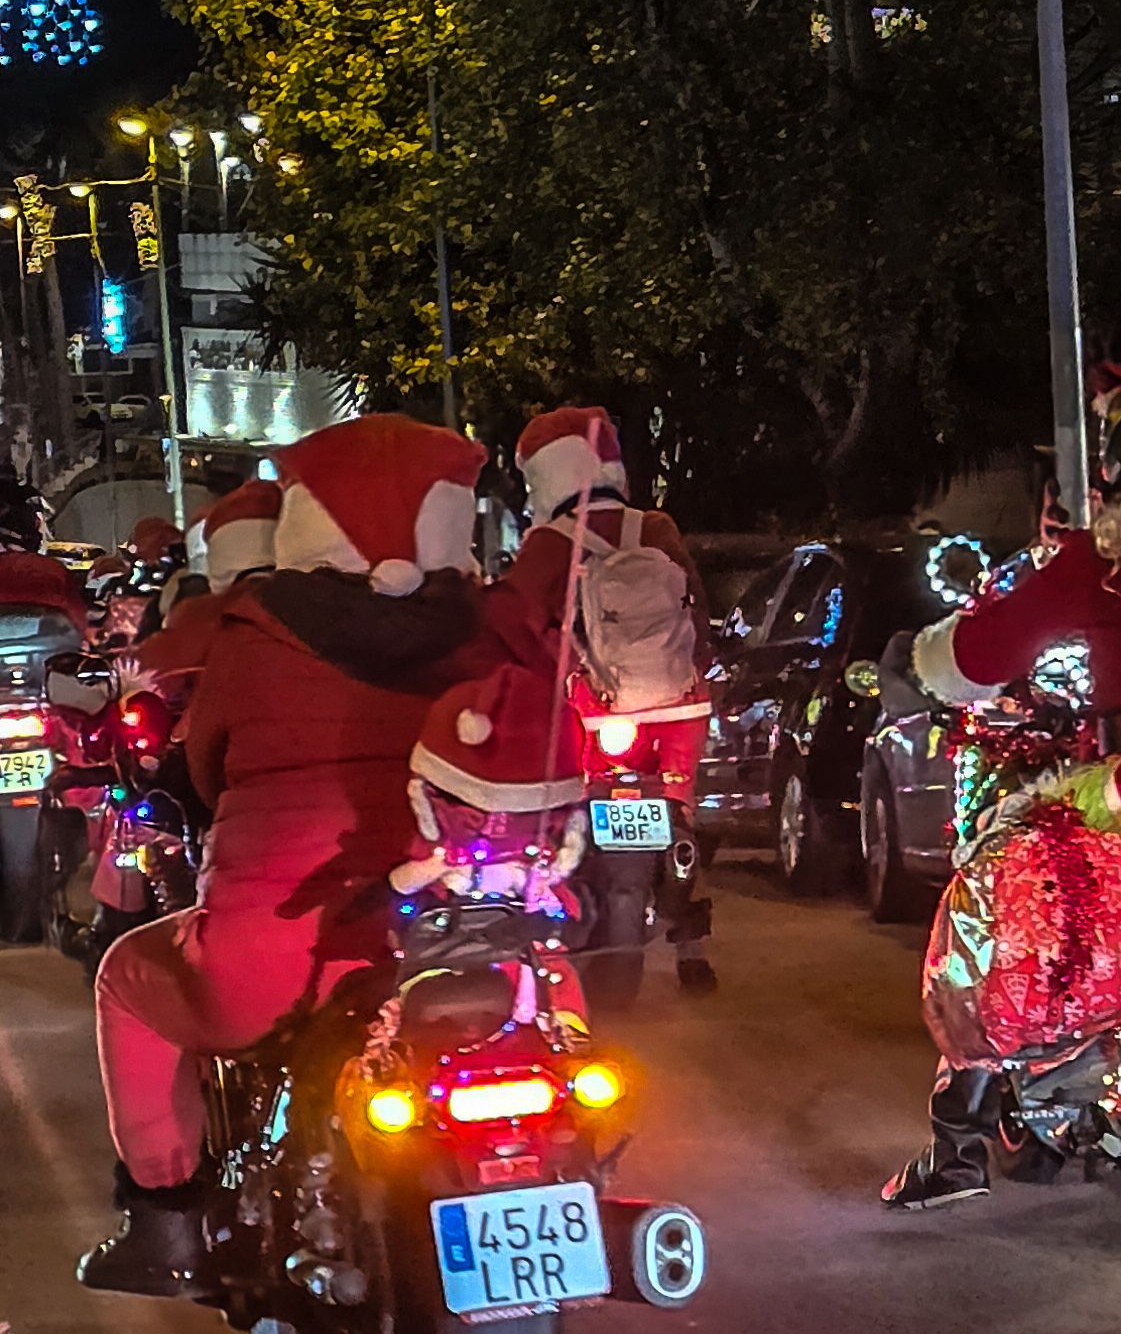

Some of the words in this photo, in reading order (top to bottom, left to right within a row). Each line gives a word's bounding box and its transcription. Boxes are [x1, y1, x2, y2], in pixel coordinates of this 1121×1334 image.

[609, 803, 662, 822] 8548
[611, 823, 650, 841] MBF
[478, 1201, 588, 1254] 4548
[481, 1252, 568, 1304] LRR
